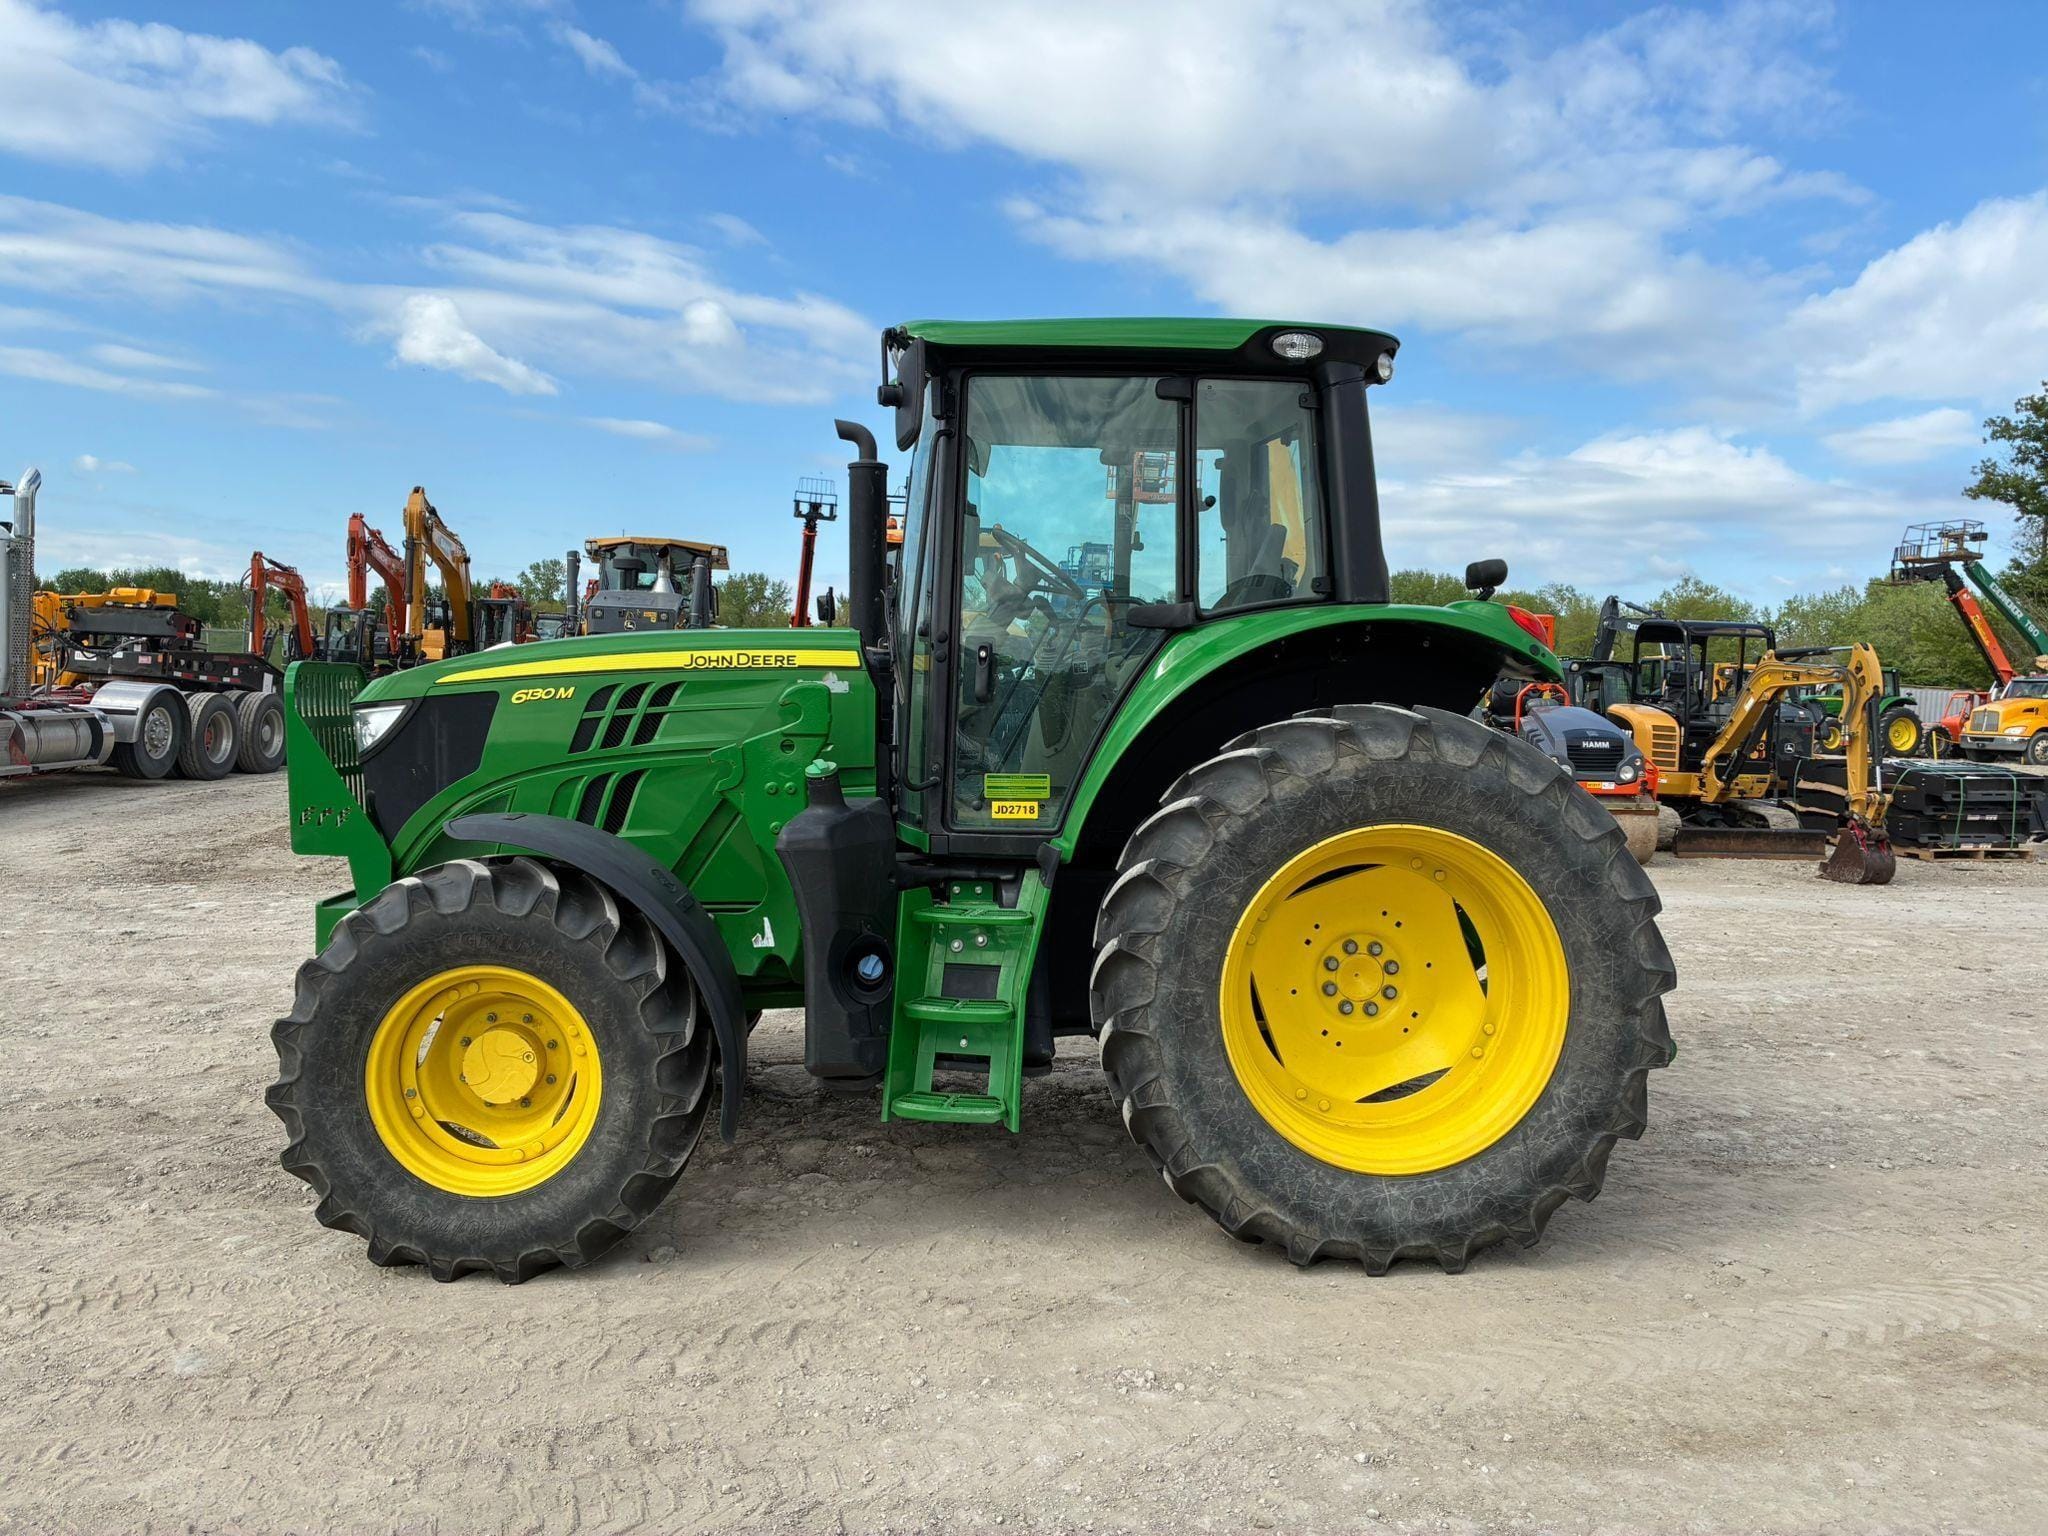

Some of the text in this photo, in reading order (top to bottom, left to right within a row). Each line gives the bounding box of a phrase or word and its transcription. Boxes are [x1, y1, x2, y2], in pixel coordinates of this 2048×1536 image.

[2024, 619, 2040, 637] T60
[683, 652, 797, 667] JOHN DEERE
[1582, 740, 1610, 749] HAMM
[994, 805, 1036, 815] JD2718
